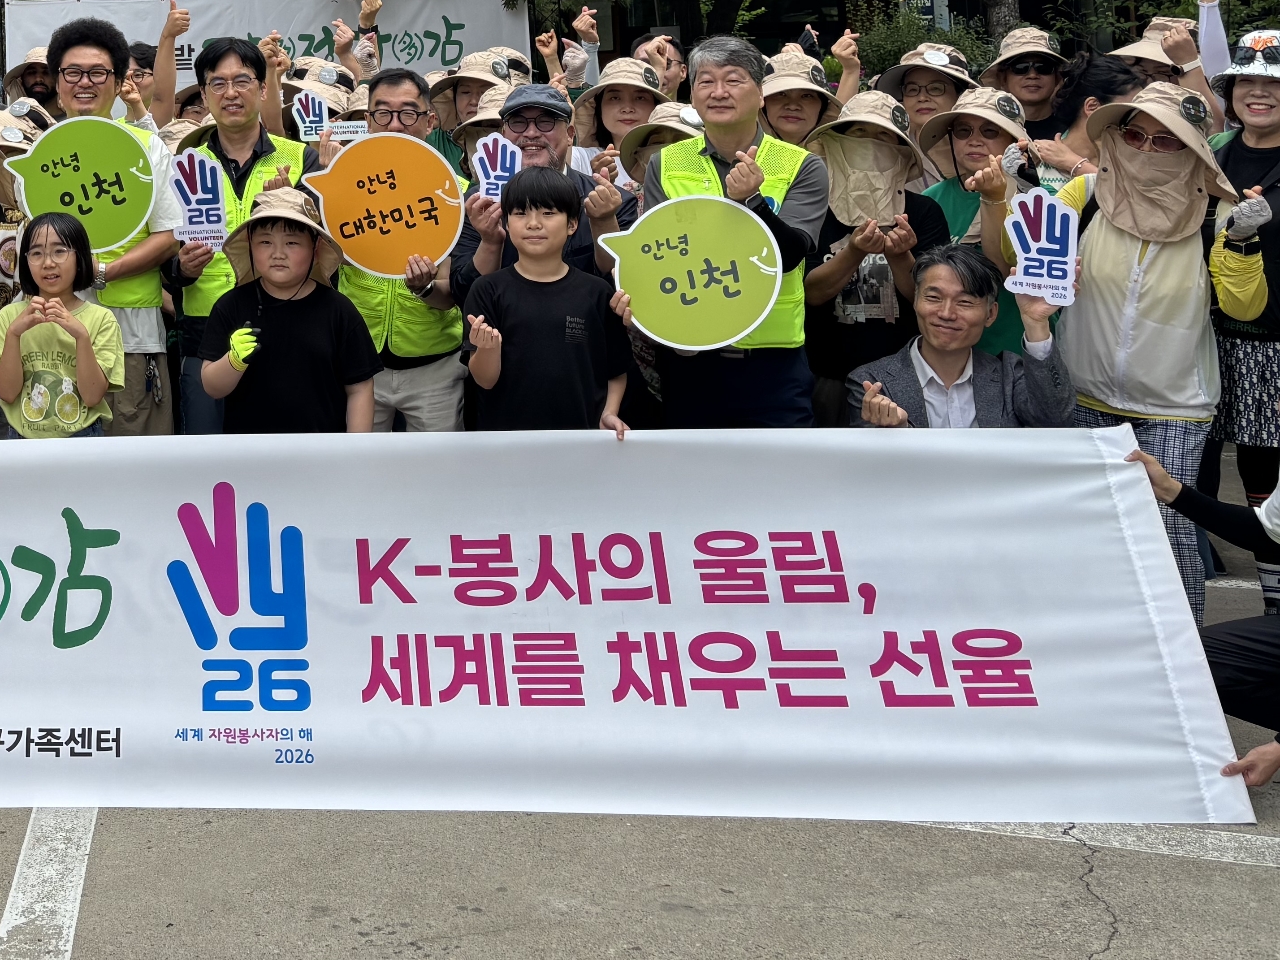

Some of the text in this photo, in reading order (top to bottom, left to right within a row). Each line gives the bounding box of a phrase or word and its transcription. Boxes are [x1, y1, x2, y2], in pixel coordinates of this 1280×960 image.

[40, 152, 80, 178] 안녕
[60, 172, 127, 215] 인천
[356, 169, 397, 195] 안녕
[187, 207, 222, 226] 26
[339, 196, 439, 239] 대한민국
[641, 233, 689, 261] 안녕
[660, 257, 742, 306] 인천
[1023, 257, 1068, 280] 26
[1050, 292, 1068, 300] 2026
[21, 351, 49, 367] REEN
[41, 362, 62, 370] RABBIT
[22, 423, 47, 432] FRUIT
[355, 530, 878, 615] K-봉사의 울림,
[361, 628, 1039, 710] 세계를 채우는 선율
[201, 659, 312, 712] 26
[174, 727, 313, 745] 세계 자원봉사자의 해
[274, 748, 315, 764] 2026
